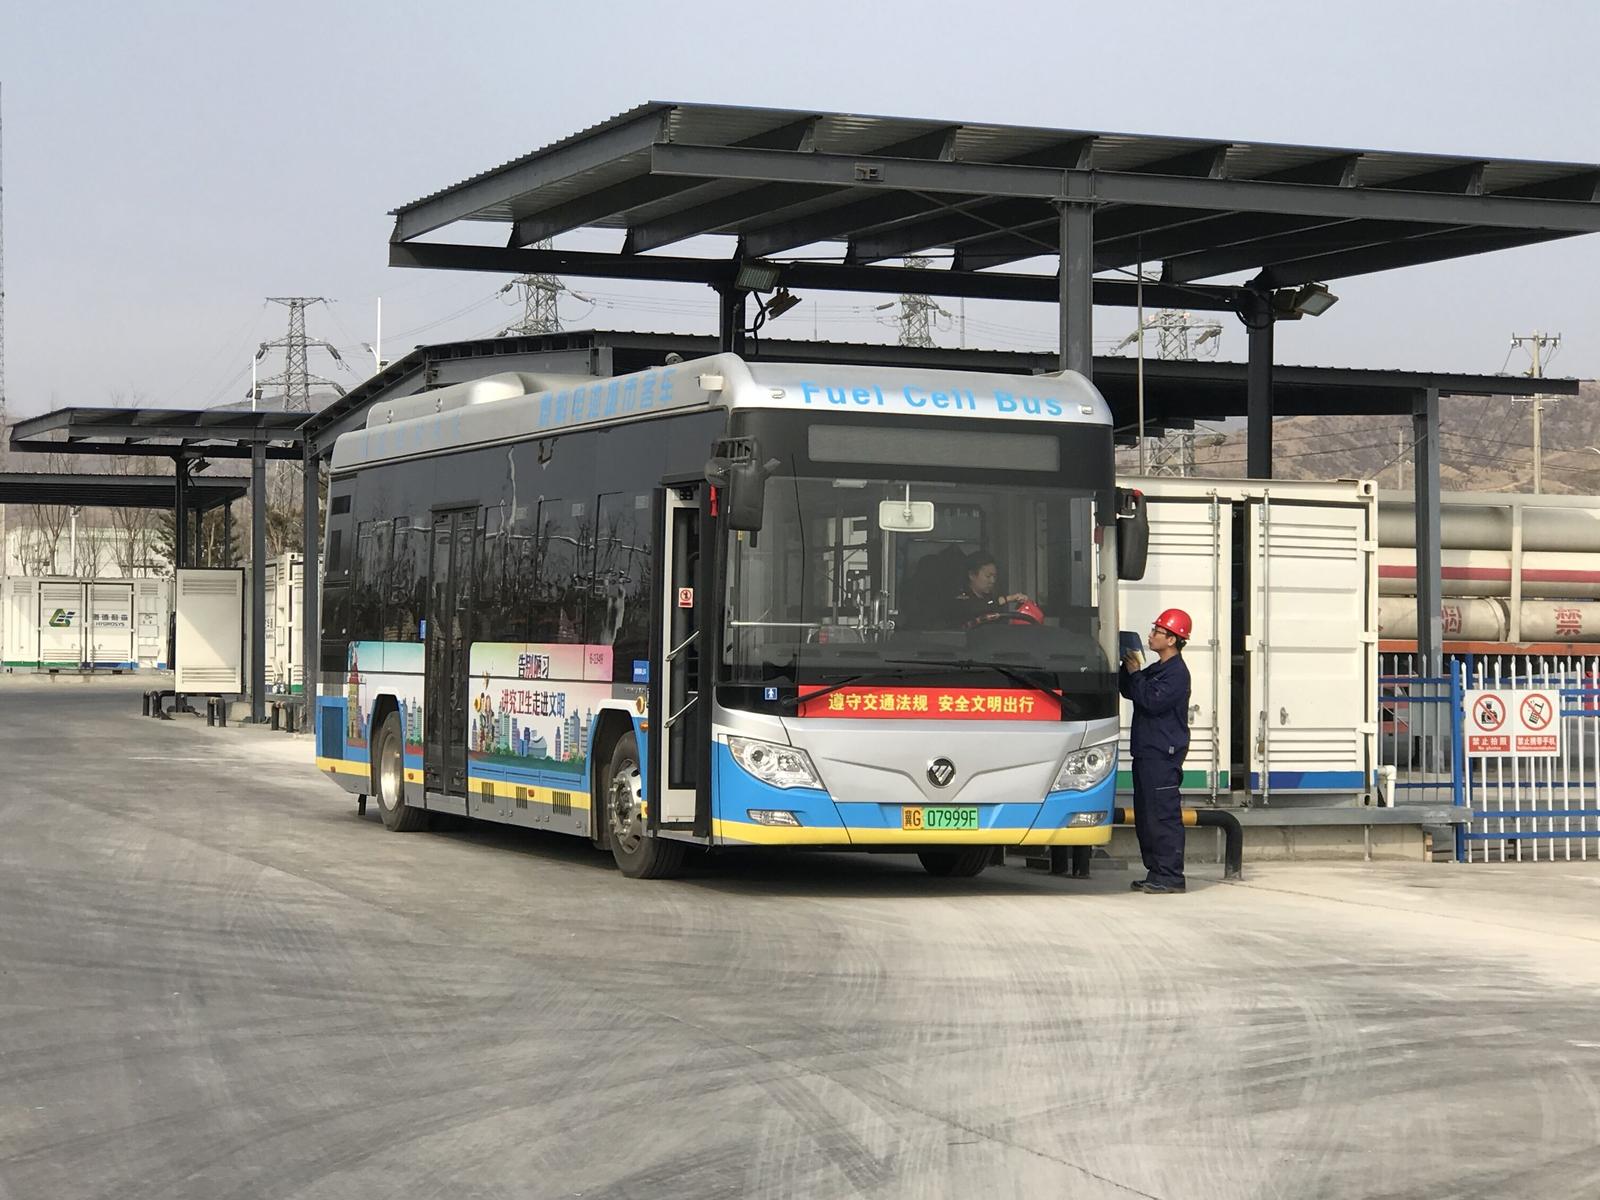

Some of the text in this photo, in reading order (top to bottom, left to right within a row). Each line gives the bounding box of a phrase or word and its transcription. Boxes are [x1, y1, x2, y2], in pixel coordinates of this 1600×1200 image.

[800, 381, 1063, 416] Fuel Cell Bus
[500, 689, 566, 718] 讲究卫生走进文明
[828, 693, 1035, 713] 遵守交通法规 安全文明出行
[904, 810, 977, 827] 冀G 07999F
